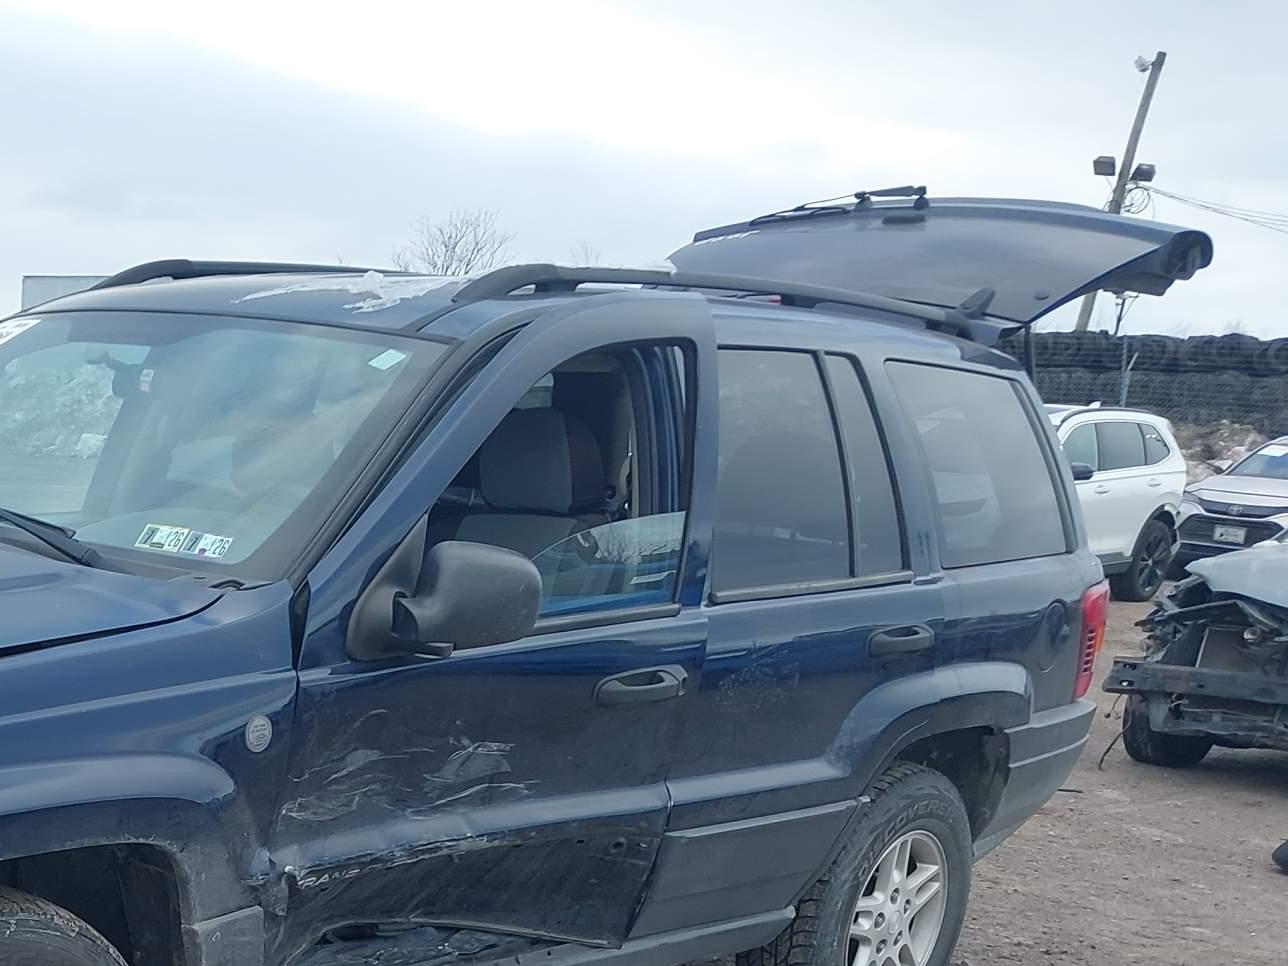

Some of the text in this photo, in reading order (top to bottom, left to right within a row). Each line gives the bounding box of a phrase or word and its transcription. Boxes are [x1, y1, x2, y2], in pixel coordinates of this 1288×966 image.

[142, 529, 185, 548] 7 26
[187, 535, 230, 556] 7 26
